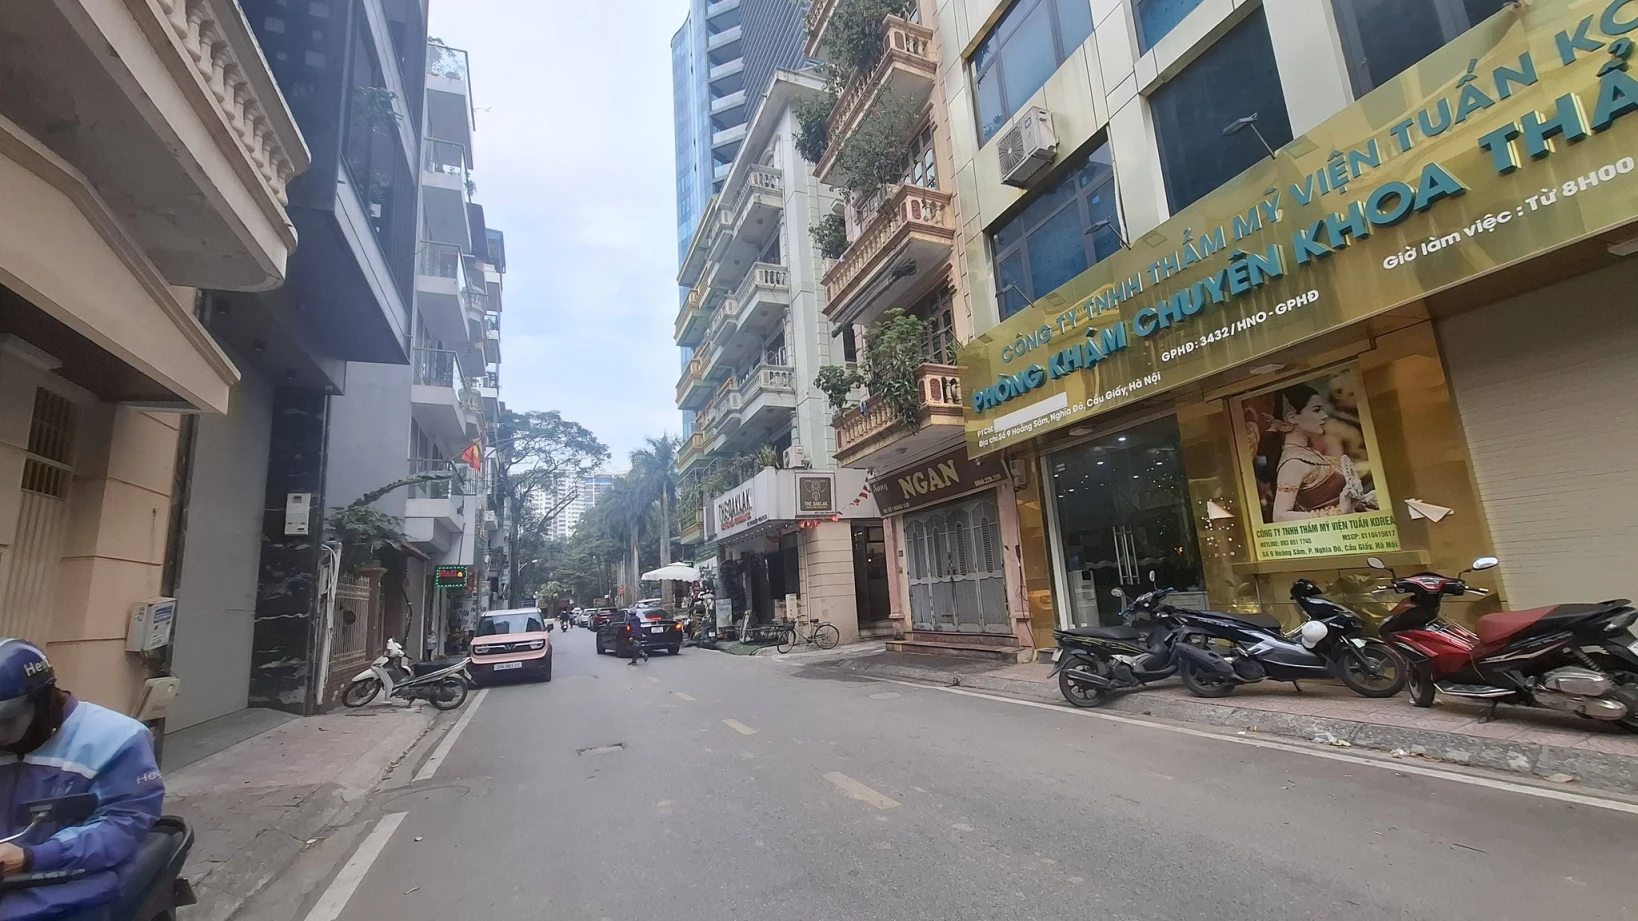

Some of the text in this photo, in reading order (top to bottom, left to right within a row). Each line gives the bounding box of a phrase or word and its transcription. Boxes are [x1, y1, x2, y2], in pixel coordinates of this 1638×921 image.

[1002, 324, 1052, 363] CÔNG
[1056, 307, 1078, 334] TY
[1084, 272, 1143, 320] TNHH
[1147, 227, 1226, 285] THẨM
[1232, 186, 1281, 241] MỸ
[1289, 138, 1381, 206] VIỆN
[1390, 51, 1539, 152] TUẤN
[1383, 246, 1417, 269] Giờ
[1421, 232, 1461, 256] làm
[1525, 188, 1557, 211] Từ
[1562, 156, 1635, 196] 8H00
[972, 364, 1047, 413] PHÒNG
[1048, 321, 1129, 379] KHÁM
[1132, 244, 1285, 337] CHUYÊN
[1293, 162, 1466, 264] KHOA
[1011, 423, 1033, 436] Hoàng
[1086, 393, 1104, 408] Cầu
[1105, 384, 1129, 401] Giấy,
[1129, 377, 1143, 391] Hà
[1144, 371, 1161, 385] Nội
[898, 459, 960, 499] NGAN
[1256, 528, 1273, 539] CÔNG
[1273, 528, 1281, 537] TY
[1281, 526, 1299, 536] TNHH
[1331, 520, 1348, 532] VIỆN
[1349, 516, 1369, 529] TUẤN
[1369, 515, 1396, 527] KOREA
